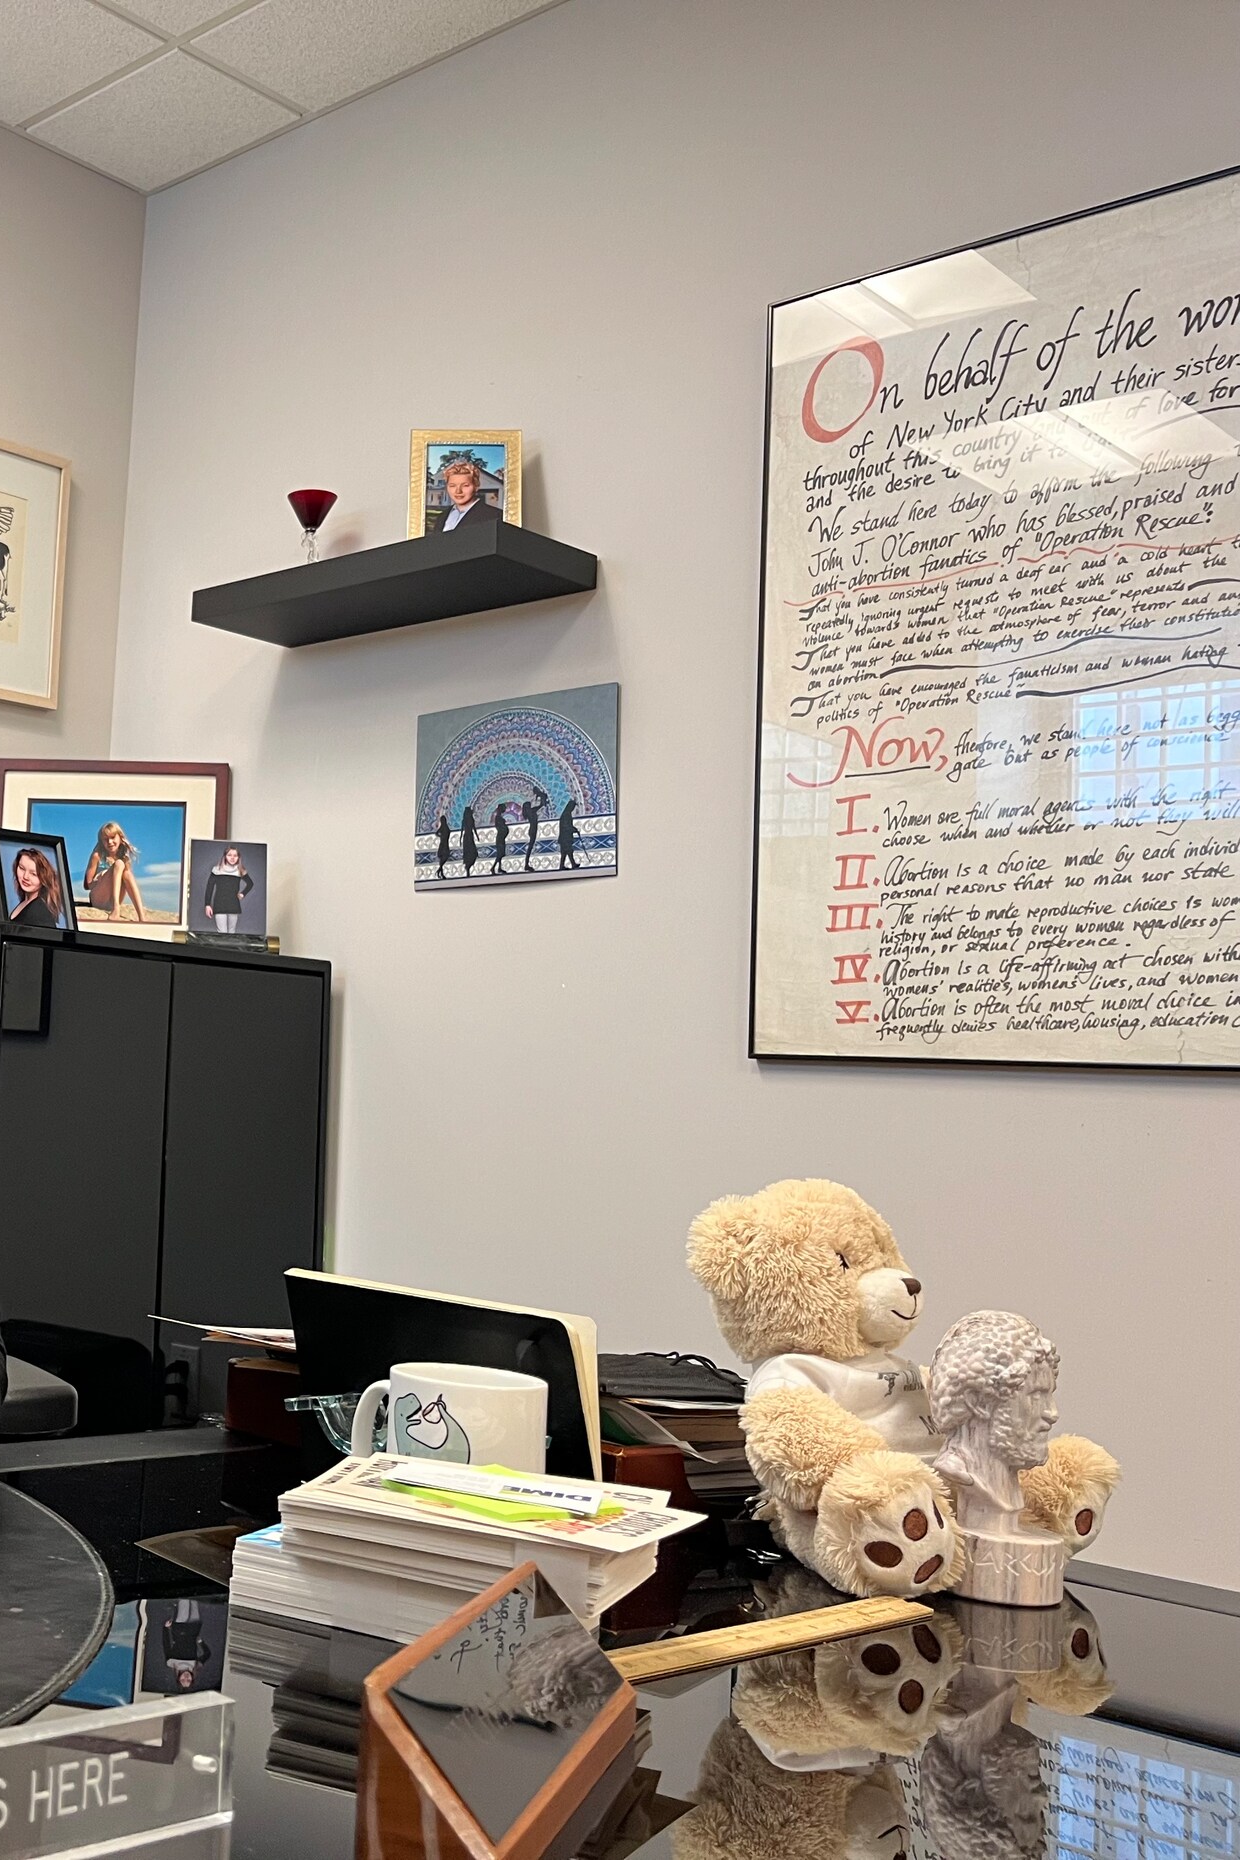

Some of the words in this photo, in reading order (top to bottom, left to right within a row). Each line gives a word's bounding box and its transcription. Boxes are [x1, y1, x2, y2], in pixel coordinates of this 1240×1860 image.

[924, 319, 1029, 404] behalf
[1036, 306, 1084, 390] of
[1095, 288, 1157, 358] the
[803, 452, 895, 491] throughout
[903, 448, 941, 470] this
[952, 426, 1022, 457] country
[1158, 391, 1199, 414] love
[1209, 377, 1240, 403] for
[850, 430, 874, 459] of
[887, 421, 935, 450] New
[944, 404, 988, 439] York
[999, 393, 1048, 422] City
[1060, 371, 1102, 408] and
[1111, 363, 1165, 394] their
[806, 490, 832, 513] and
[848, 481, 876, 502] the
[886, 473, 935, 493] desire
[808, 506, 846, 543] We
[850, 500, 906, 535] stand
[908, 499, 938, 523] here
[948, 492, 993, 523] today
[1003, 479, 1017, 505] to
[1030, 476, 1082, 506] affirm
[1090, 467, 1121, 487] the
[1134, 450, 1224, 487] following
[808, 548, 844, 578] John
[852, 537, 875, 567] J.
[881, 530, 960, 562] O'Connor
[967, 514, 1006, 545] who
[1015, 506, 1048, 534] has
[1056, 496, 1118, 527] blessed,
[1121, 483, 1186, 521] praised
[1196, 473, 1239, 498] and
[811, 563, 911, 597] anti-abortion
[919, 550, 988, 580] fanatics
[1002, 537, 1023, 565] of
[1035, 521, 1124, 552] "Operation
[888, 579, 949, 601] consistently
[1178, 538, 1222, 556] heart
[1120, 582, 1184, 600] represents
[910, 679, 968, 695] encouraged
[786, 716, 949, 787] Now,
[884, 801, 931, 831] Women
[937, 812, 961, 825] are
[966, 799, 999, 833] full
[997, 797, 1041, 819] moral
[884, 855, 949, 886] Abortion
[977, 864, 988, 875] a
[997, 850, 1053, 875] choice
[1064, 848, 1104, 866] made
[1114, 844, 1135, 871] by
[1143, 839, 1180, 859] each
[886, 902, 918, 929] The
[922, 905, 963, 930] right
[966, 905, 980, 921] to
[985, 902, 1020, 920] make
[1027, 900, 1116, 922] reproductive
[1123, 897, 1178, 914] choices
[883, 959, 950, 986] Abortion
[882, 997, 945, 1022] Abortion
[954, 1003, 967, 1015] is
[974, 995, 1009, 1023] often
[1016, 994, 1041, 1014] the
[1049, 994, 1094, 1013] most
[502, 1485, 592, 1502] DIME
[28, 1751, 130, 1824] HERE
